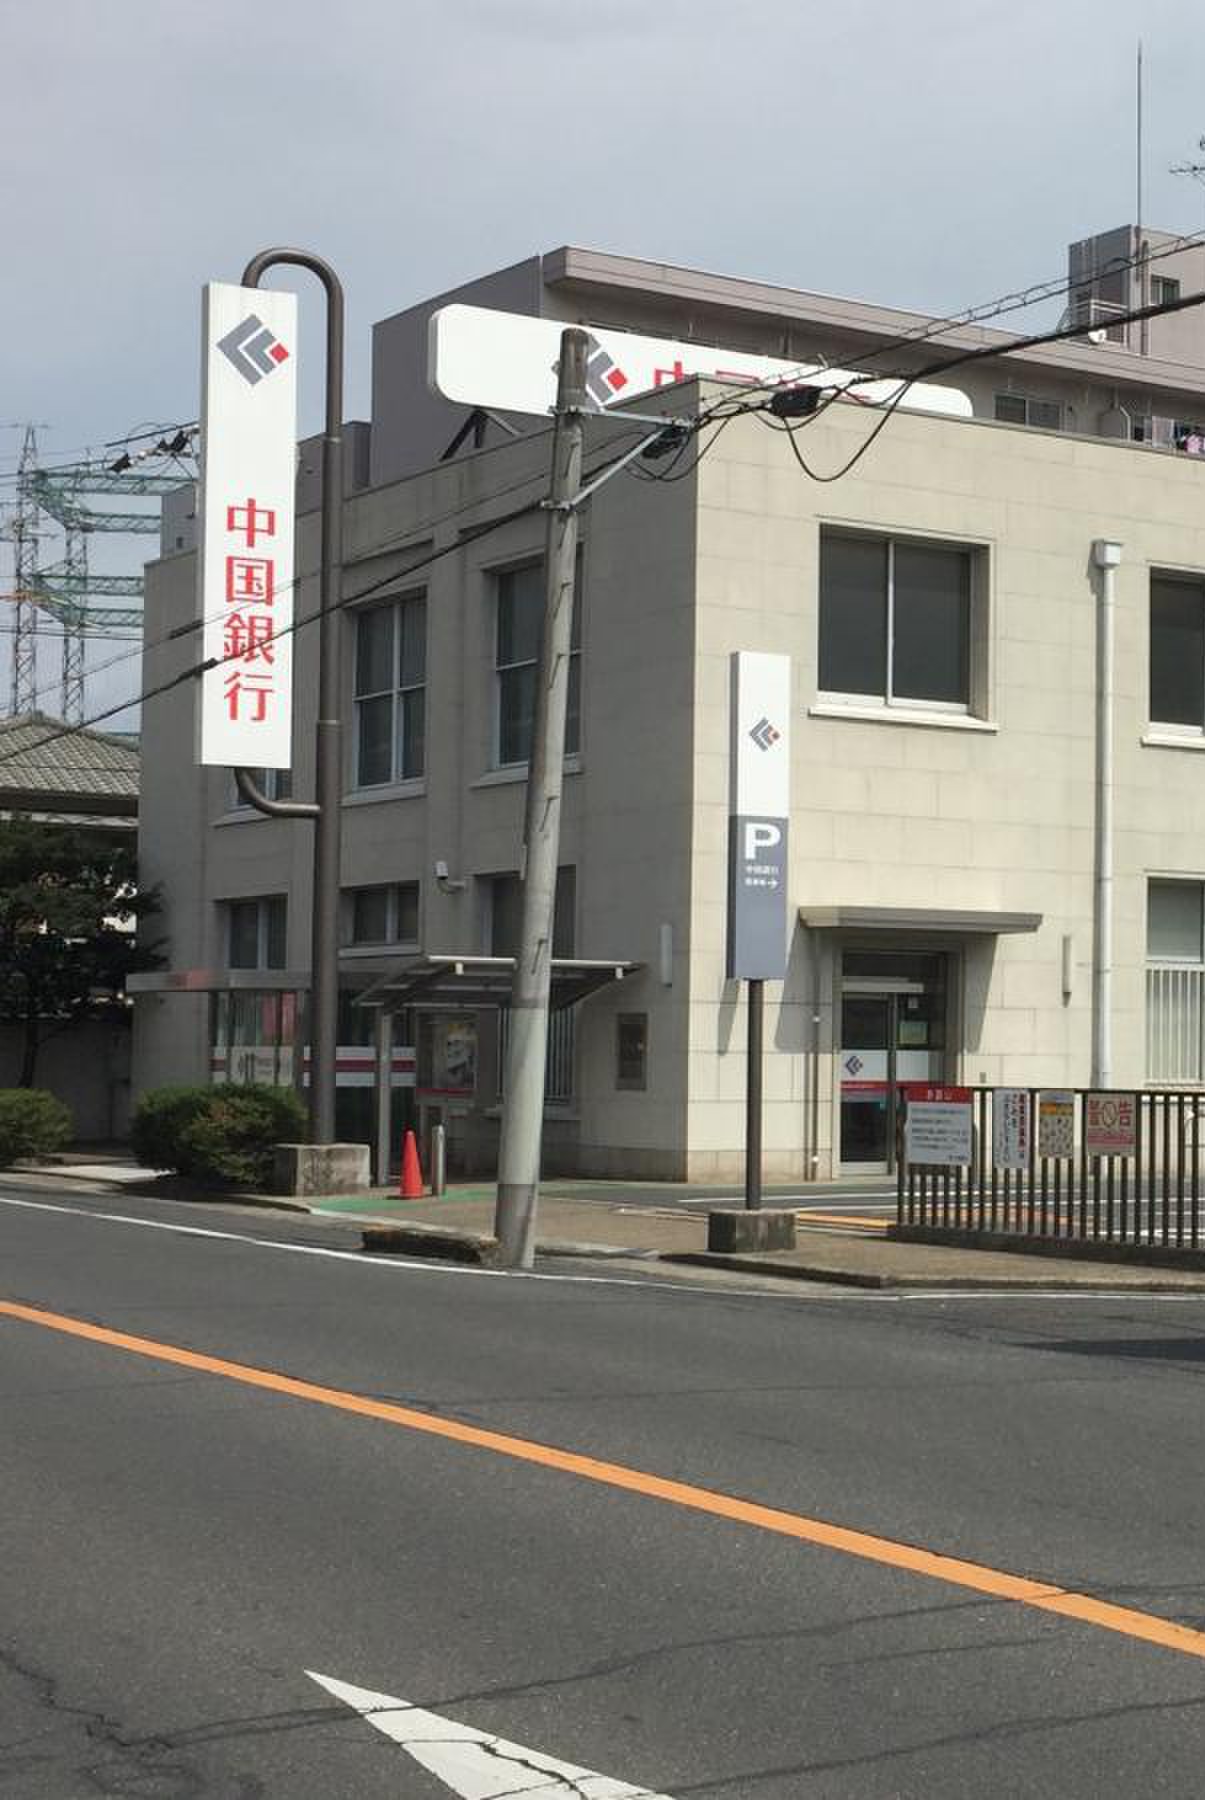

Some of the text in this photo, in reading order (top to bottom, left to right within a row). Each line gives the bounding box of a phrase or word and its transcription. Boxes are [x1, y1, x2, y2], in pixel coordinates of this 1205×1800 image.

[223, 498, 275, 721] 中国銀行
[744, 822, 781, 860] P
